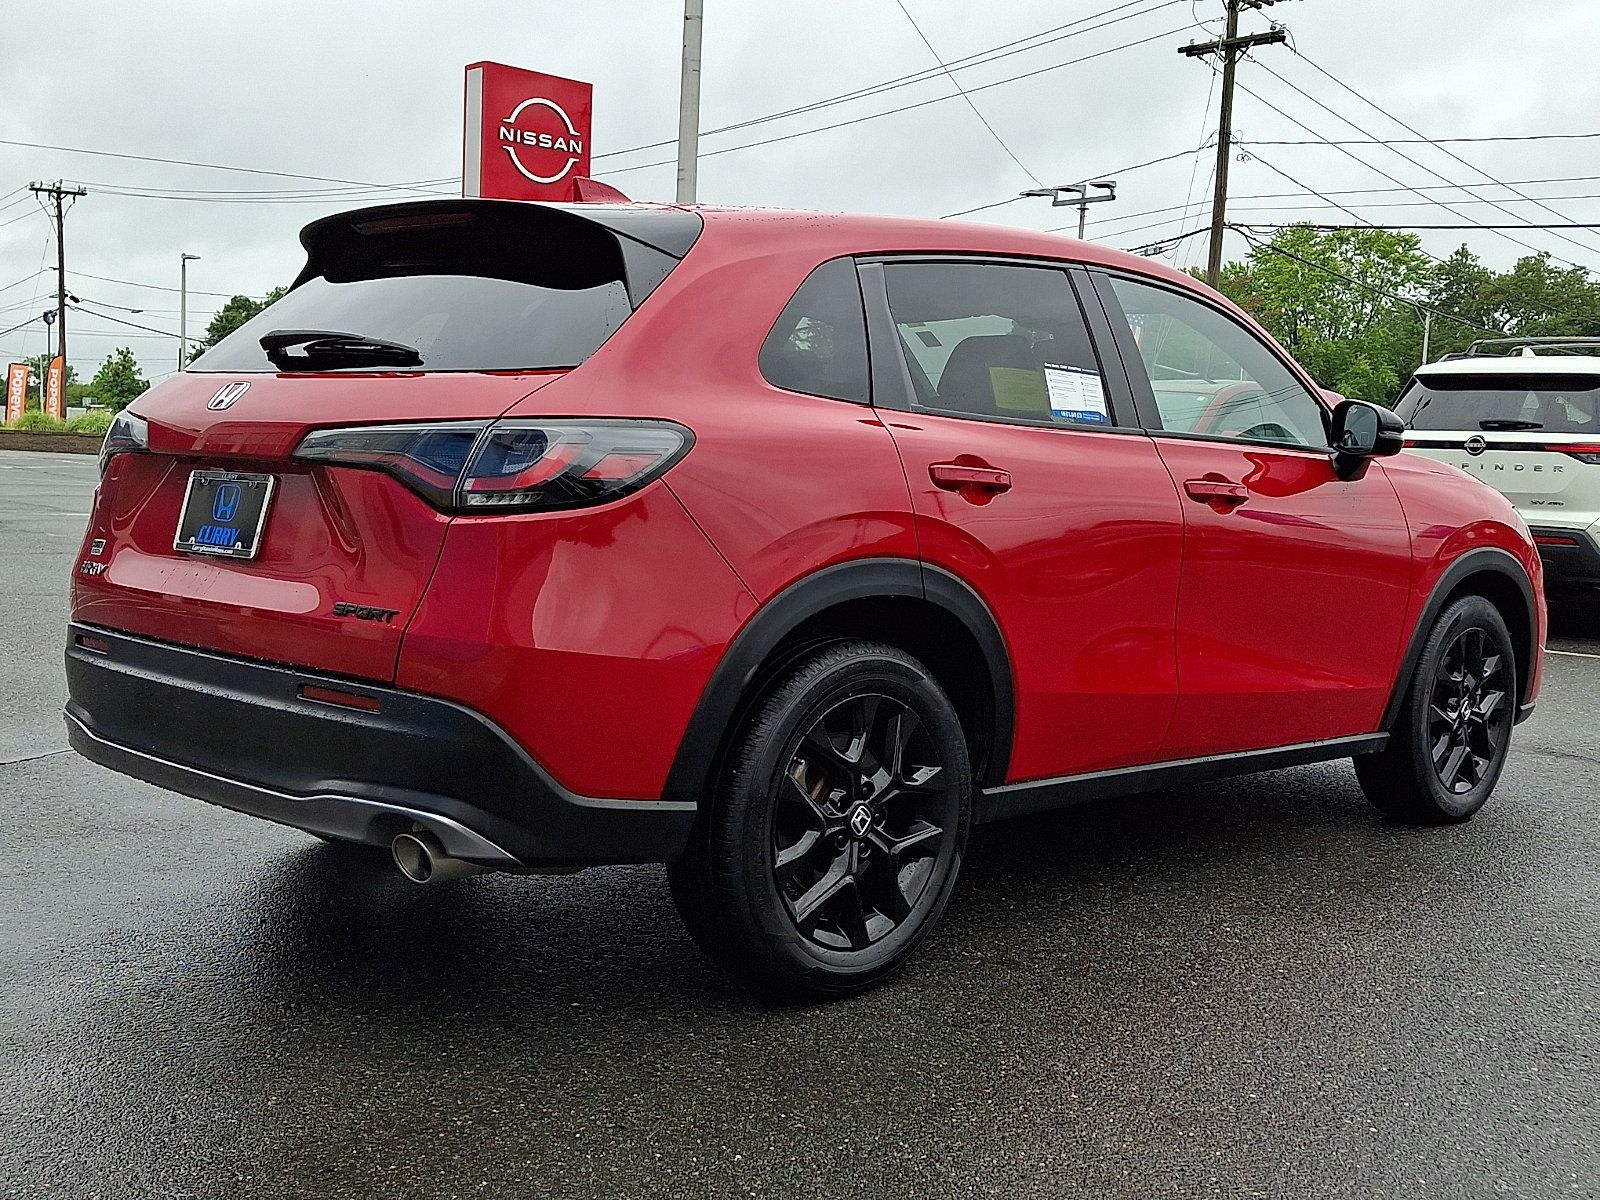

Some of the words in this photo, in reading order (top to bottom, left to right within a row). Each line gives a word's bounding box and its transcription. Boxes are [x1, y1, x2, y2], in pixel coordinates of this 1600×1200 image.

[499, 126, 583, 154] NISSAN
[1459, 462, 1564, 473] FINDER
[197, 525, 241, 546] CURRY
[332, 601, 402, 624] SPORT
